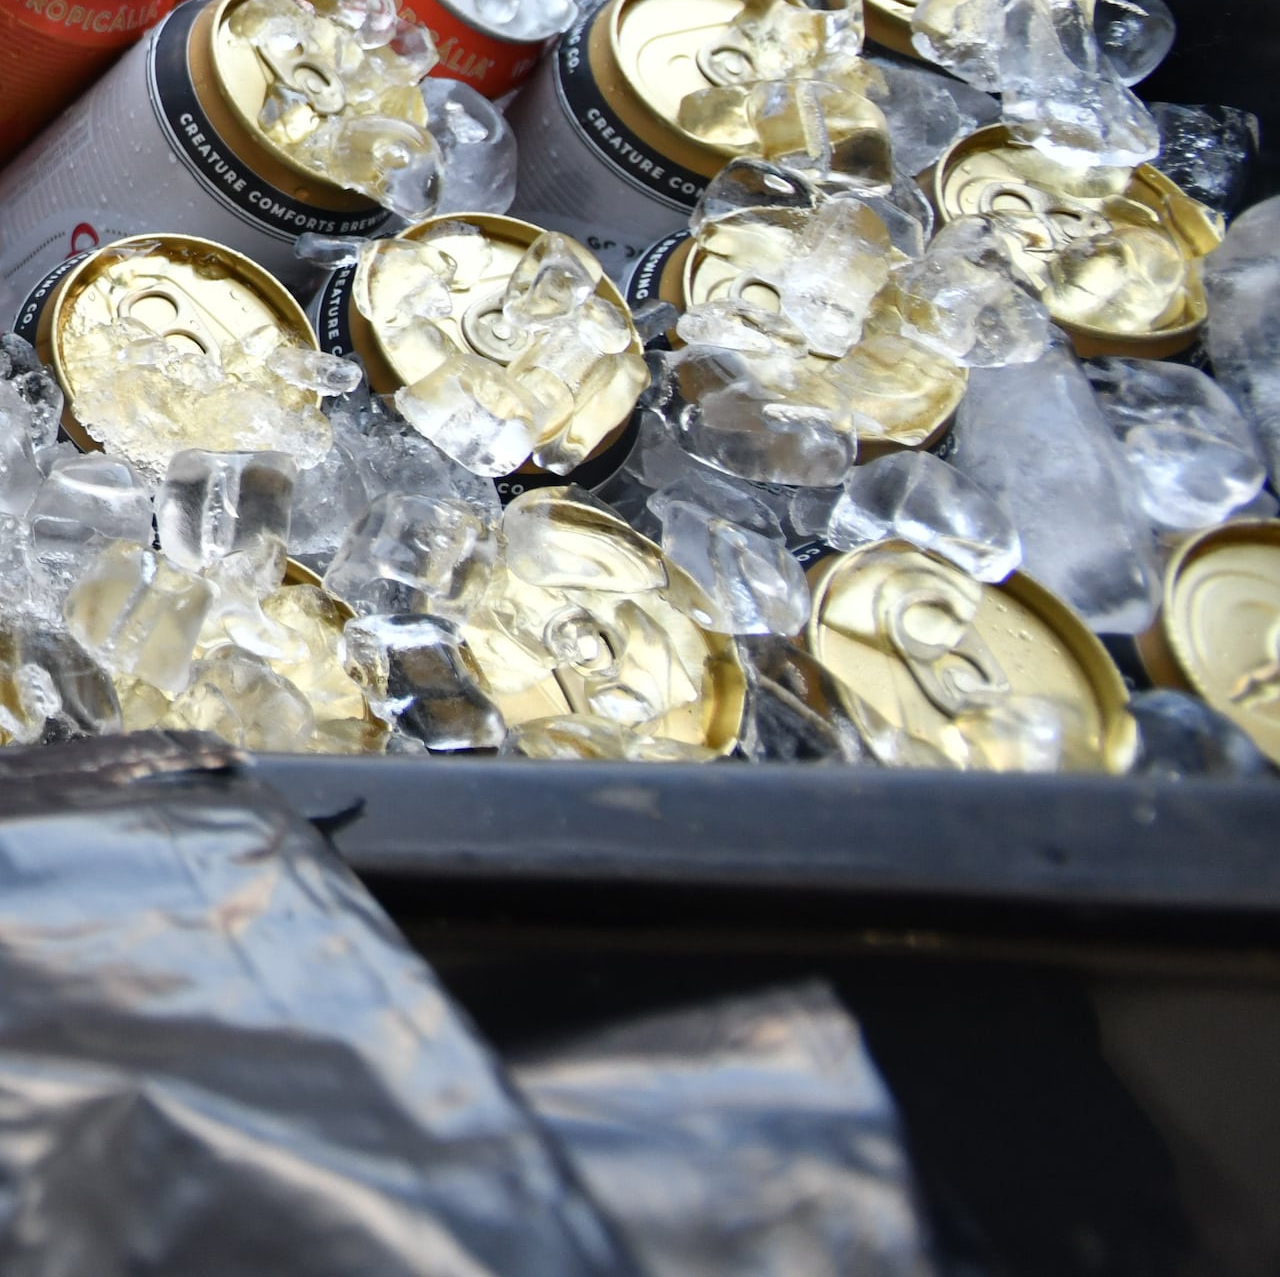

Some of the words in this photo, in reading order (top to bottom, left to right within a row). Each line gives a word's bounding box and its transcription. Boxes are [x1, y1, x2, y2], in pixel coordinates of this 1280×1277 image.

[566, 46, 581, 74] CO.
[179, 112, 248, 193] CREATURE
[247, 190, 335, 233] COMFORTS
[586, 106, 666, 181] CREATURE
[327, 265, 354, 341] REATURE
[635, 237, 678, 300] BREWING
[19, 302, 39, 330] CO.
